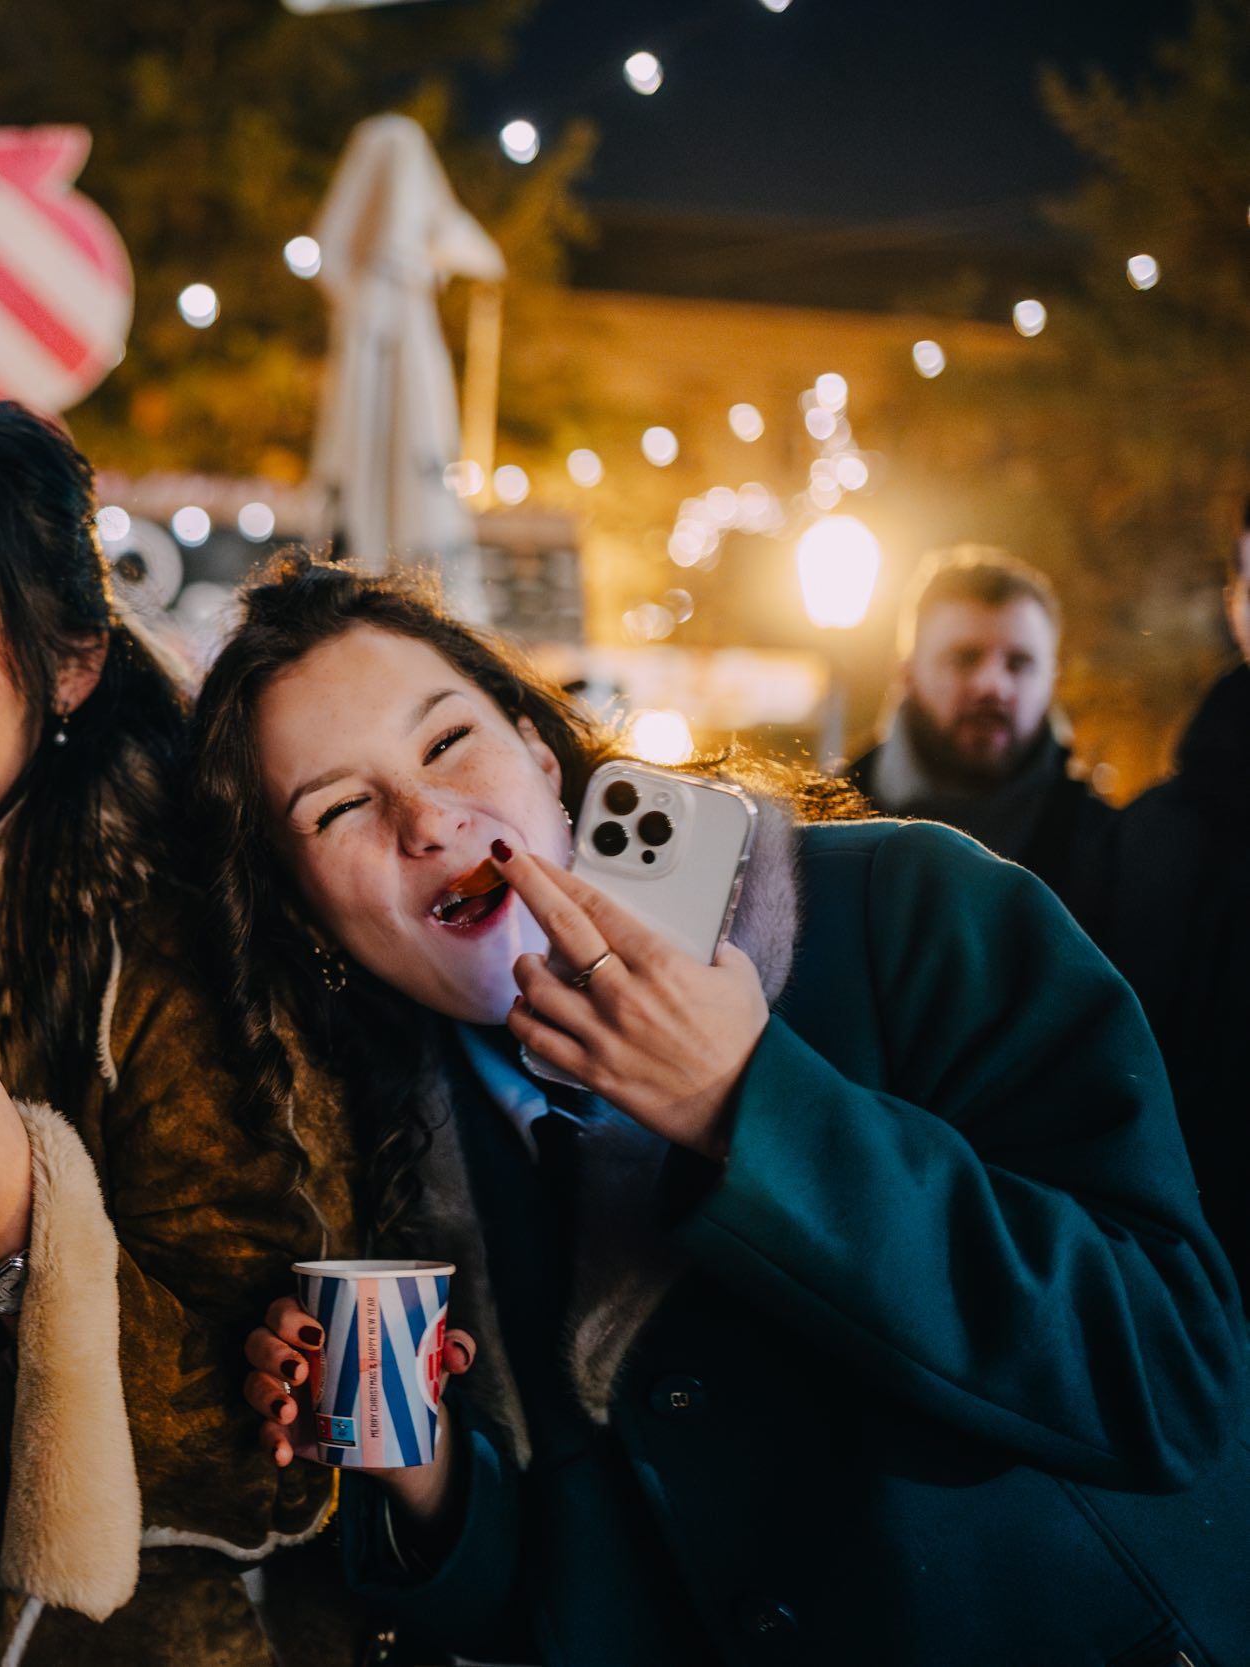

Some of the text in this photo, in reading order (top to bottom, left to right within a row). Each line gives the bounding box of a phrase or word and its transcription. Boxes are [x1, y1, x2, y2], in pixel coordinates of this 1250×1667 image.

[366, 1297, 375, 1316] YEAR
[367, 1316, 376, 1335] NEW
[368, 1337, 377, 1361] HAPPY
[369, 1370, 378, 1412] CHRISTMAS
[370, 1414, 380, 1438] MERRY
